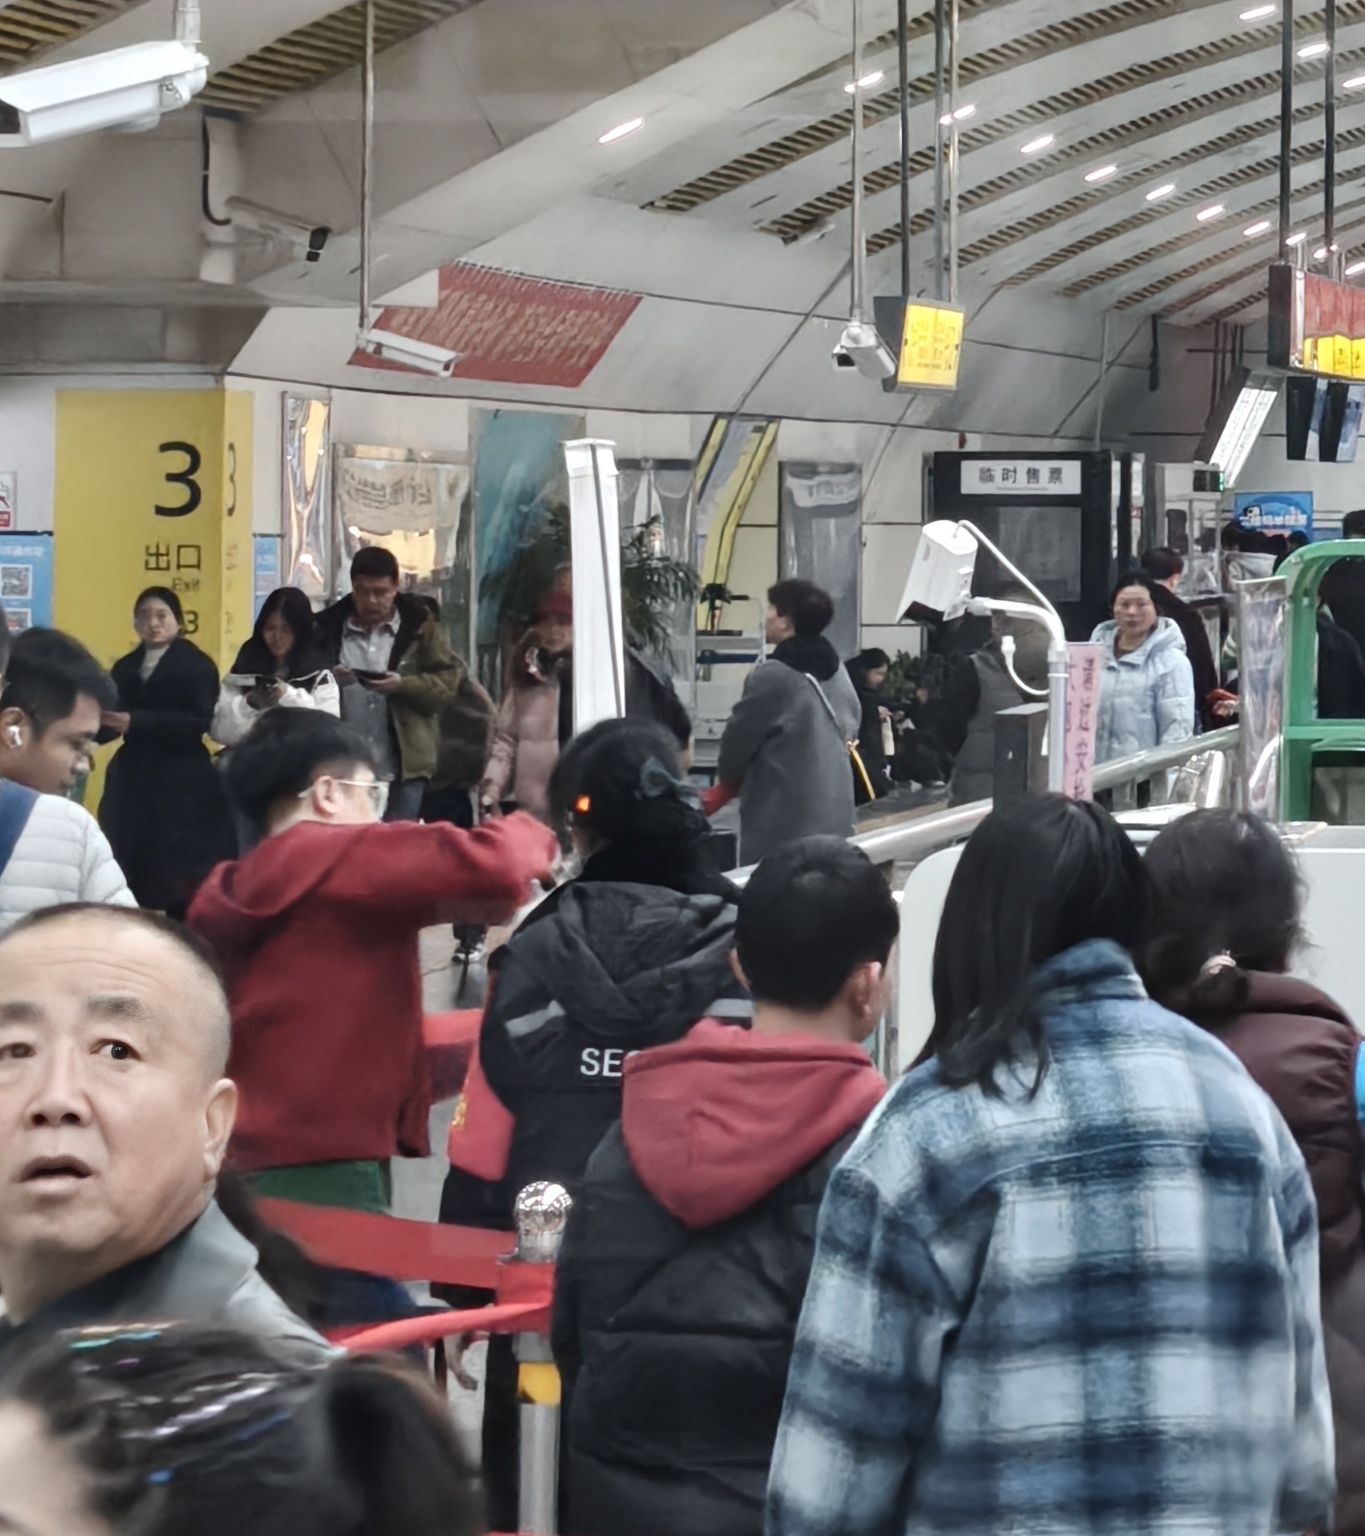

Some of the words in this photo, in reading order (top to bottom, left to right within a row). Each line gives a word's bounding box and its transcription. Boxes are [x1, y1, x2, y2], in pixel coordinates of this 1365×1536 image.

[154, 441, 202, 517] 3
[979, 467, 1063, 484] 临时售票
[144, 541, 202, 571] 出口
[172, 577, 200, 591] Exit
[580, 1048, 640, 1077] SE
